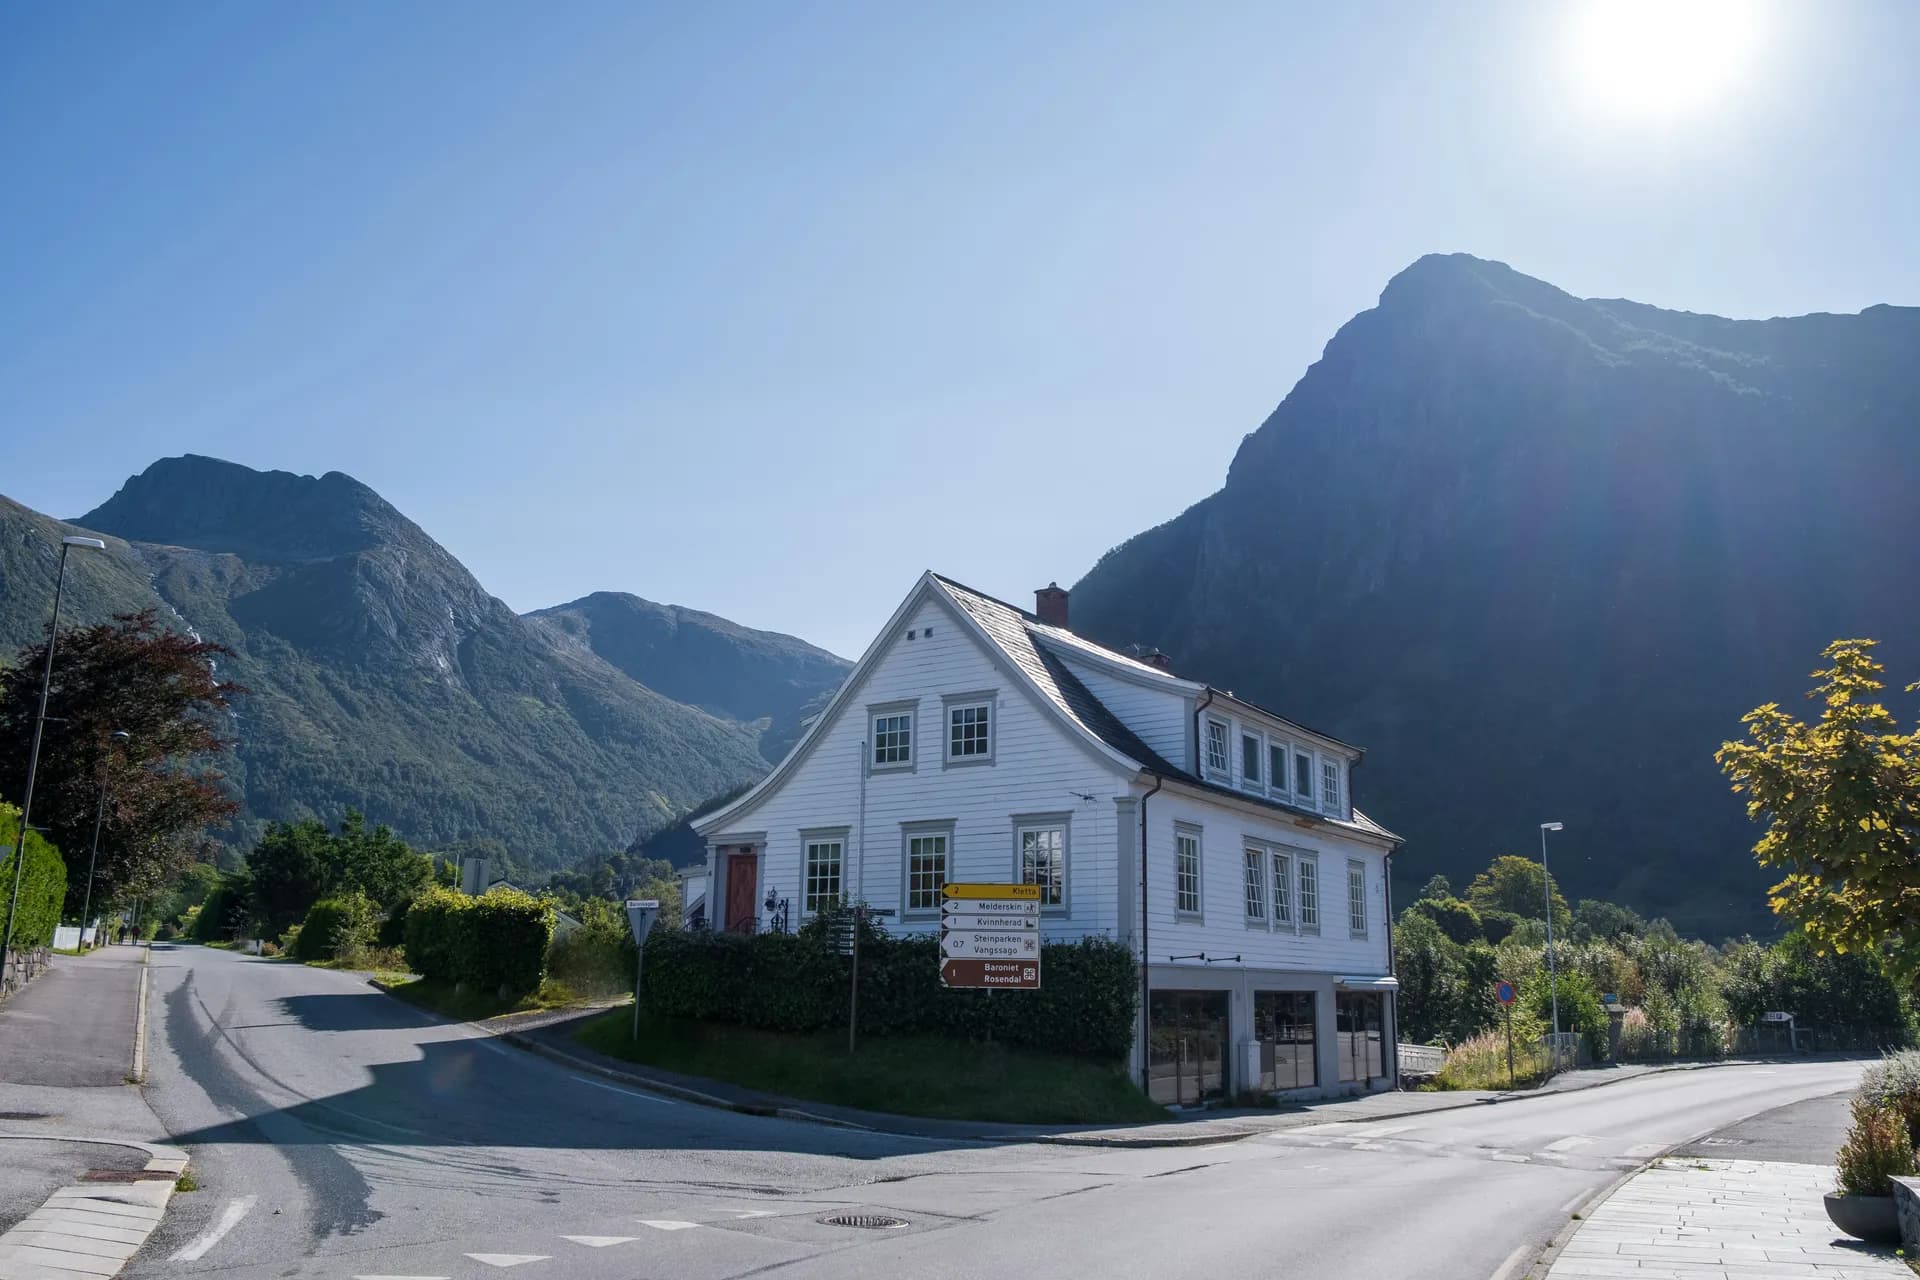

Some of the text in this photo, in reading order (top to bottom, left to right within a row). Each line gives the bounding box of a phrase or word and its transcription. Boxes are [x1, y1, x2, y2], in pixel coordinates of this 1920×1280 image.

[953, 902, 959, 910] 2
[977, 918, 1022, 926] Kvinnherad
[974, 934, 1022, 944] Steinparken
[974, 947, 1018, 956] Vangssago
[984, 963, 1019, 972] Baroniet
[984, 975, 1022, 984] Rosendal
